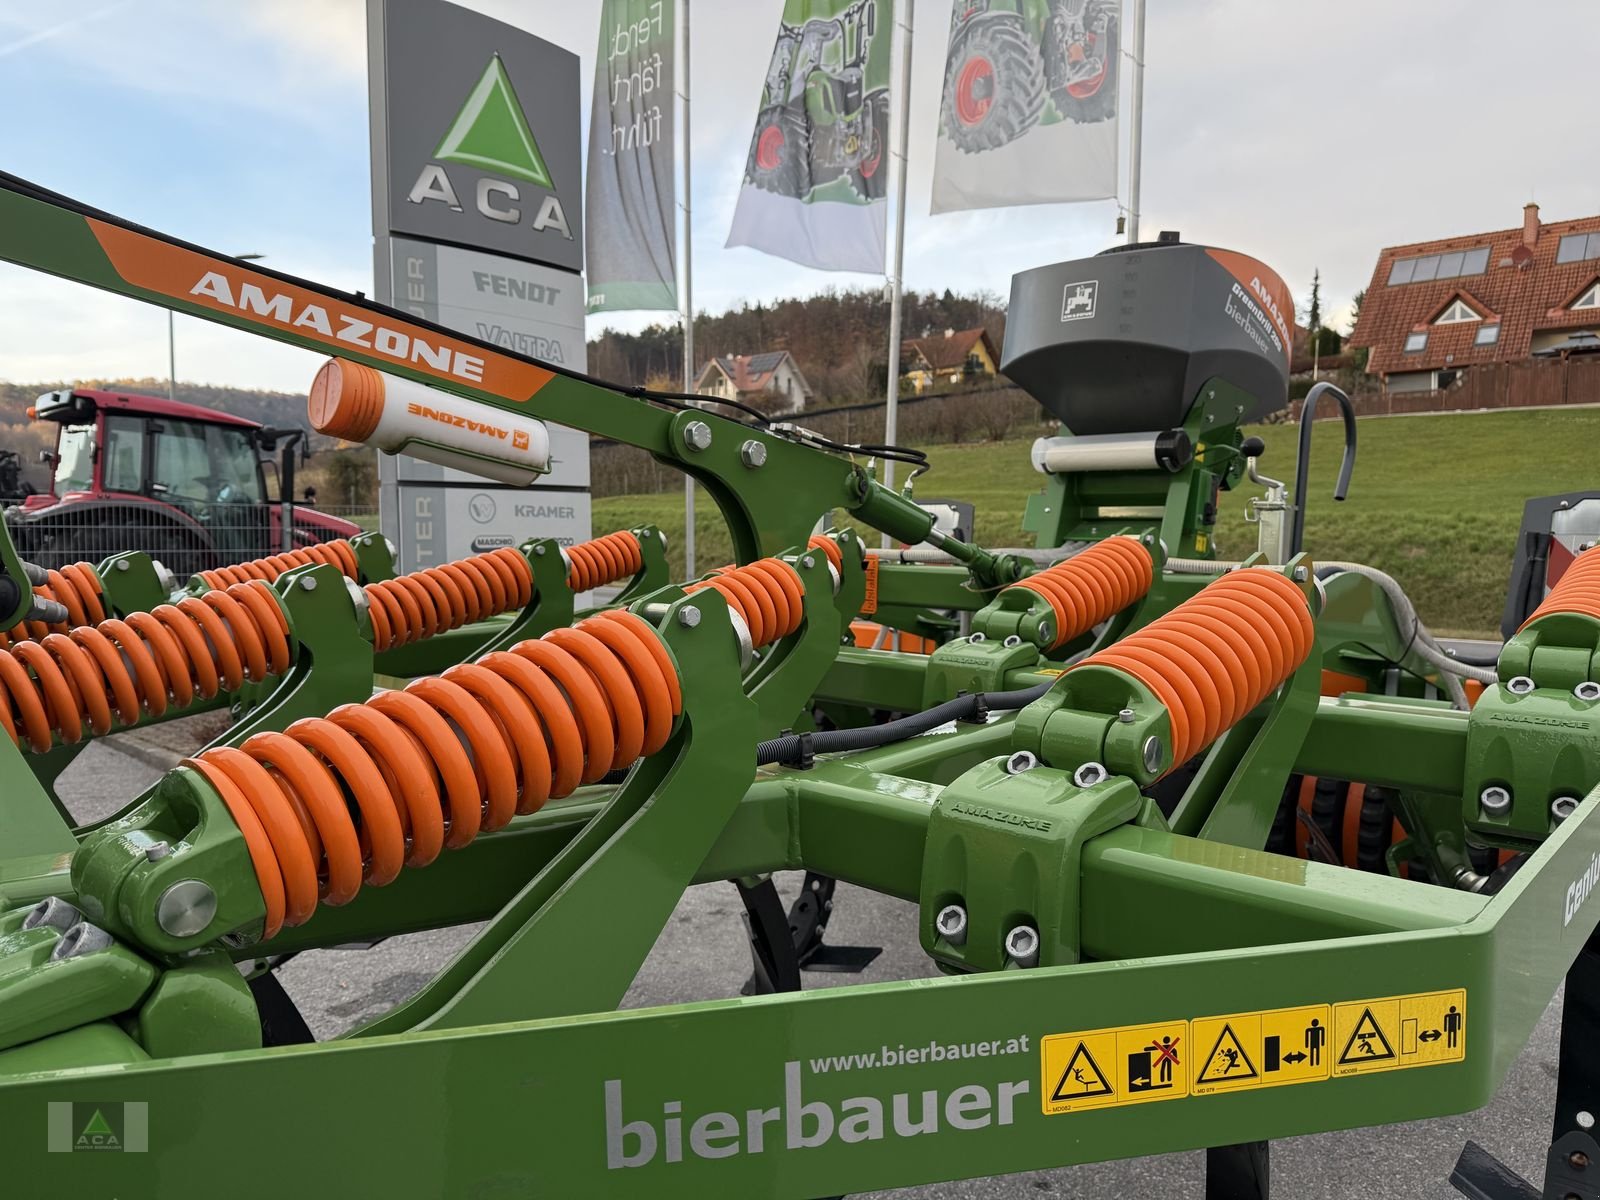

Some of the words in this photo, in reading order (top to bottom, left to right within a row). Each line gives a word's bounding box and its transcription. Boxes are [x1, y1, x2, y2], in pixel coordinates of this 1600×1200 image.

[408, 164, 574, 241] ACA
[472, 271, 561, 306] FENDT
[189, 270, 485, 384] AMAZONE
[1224, 293, 1269, 354] bierbauer
[407, 402, 509, 441] AMAZONE
[514, 504, 575, 519] KRAMER
[477, 537, 512, 546] MASCHIO
[809, 1034, 1030, 1074] www.bierbauer.at
[604, 1060, 1030, 1170] bierbauer
